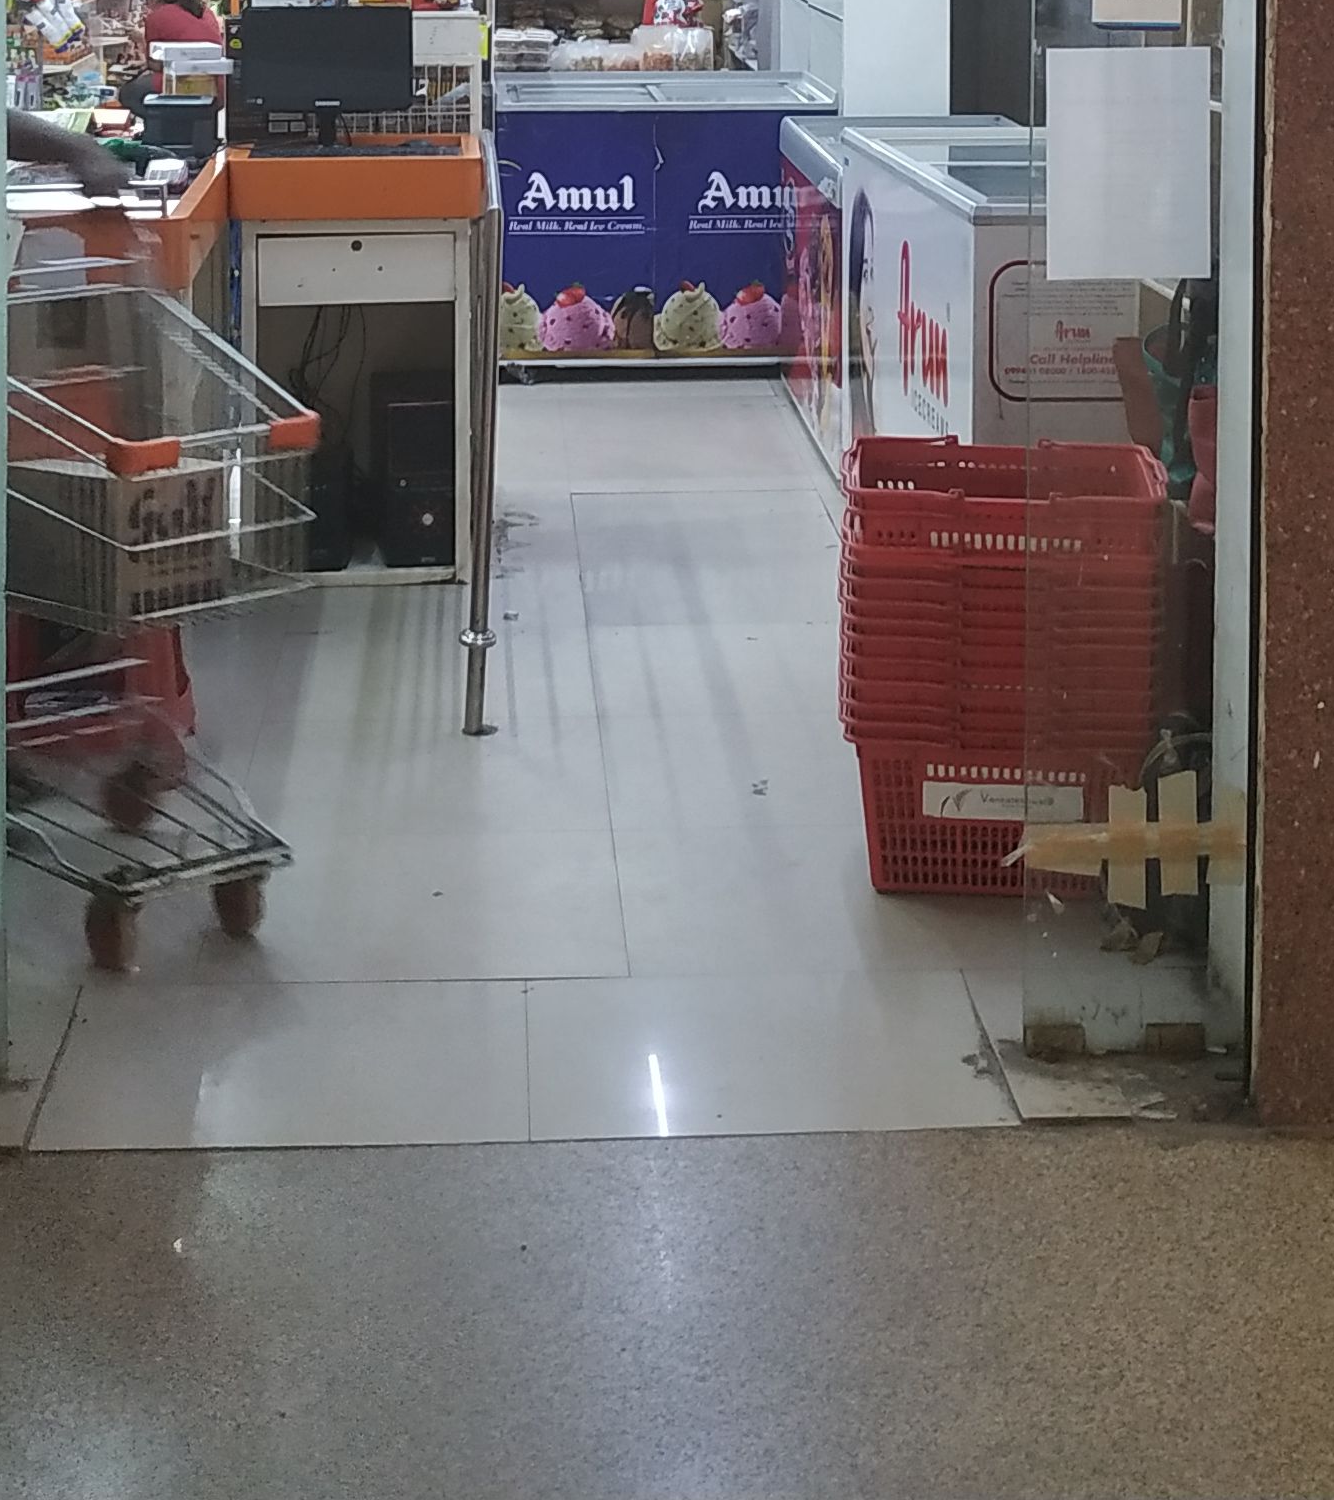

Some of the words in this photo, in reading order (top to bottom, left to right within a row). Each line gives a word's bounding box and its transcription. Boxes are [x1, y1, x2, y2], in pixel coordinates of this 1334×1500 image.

[517, 171, 636, 215] Amul
[508, 220, 533, 231] Real
[565, 220, 589, 231] Real
[689, 219, 714, 230] Real
[744, 220, 768, 230] Real
[1030, 353, 1056, 364] Call
